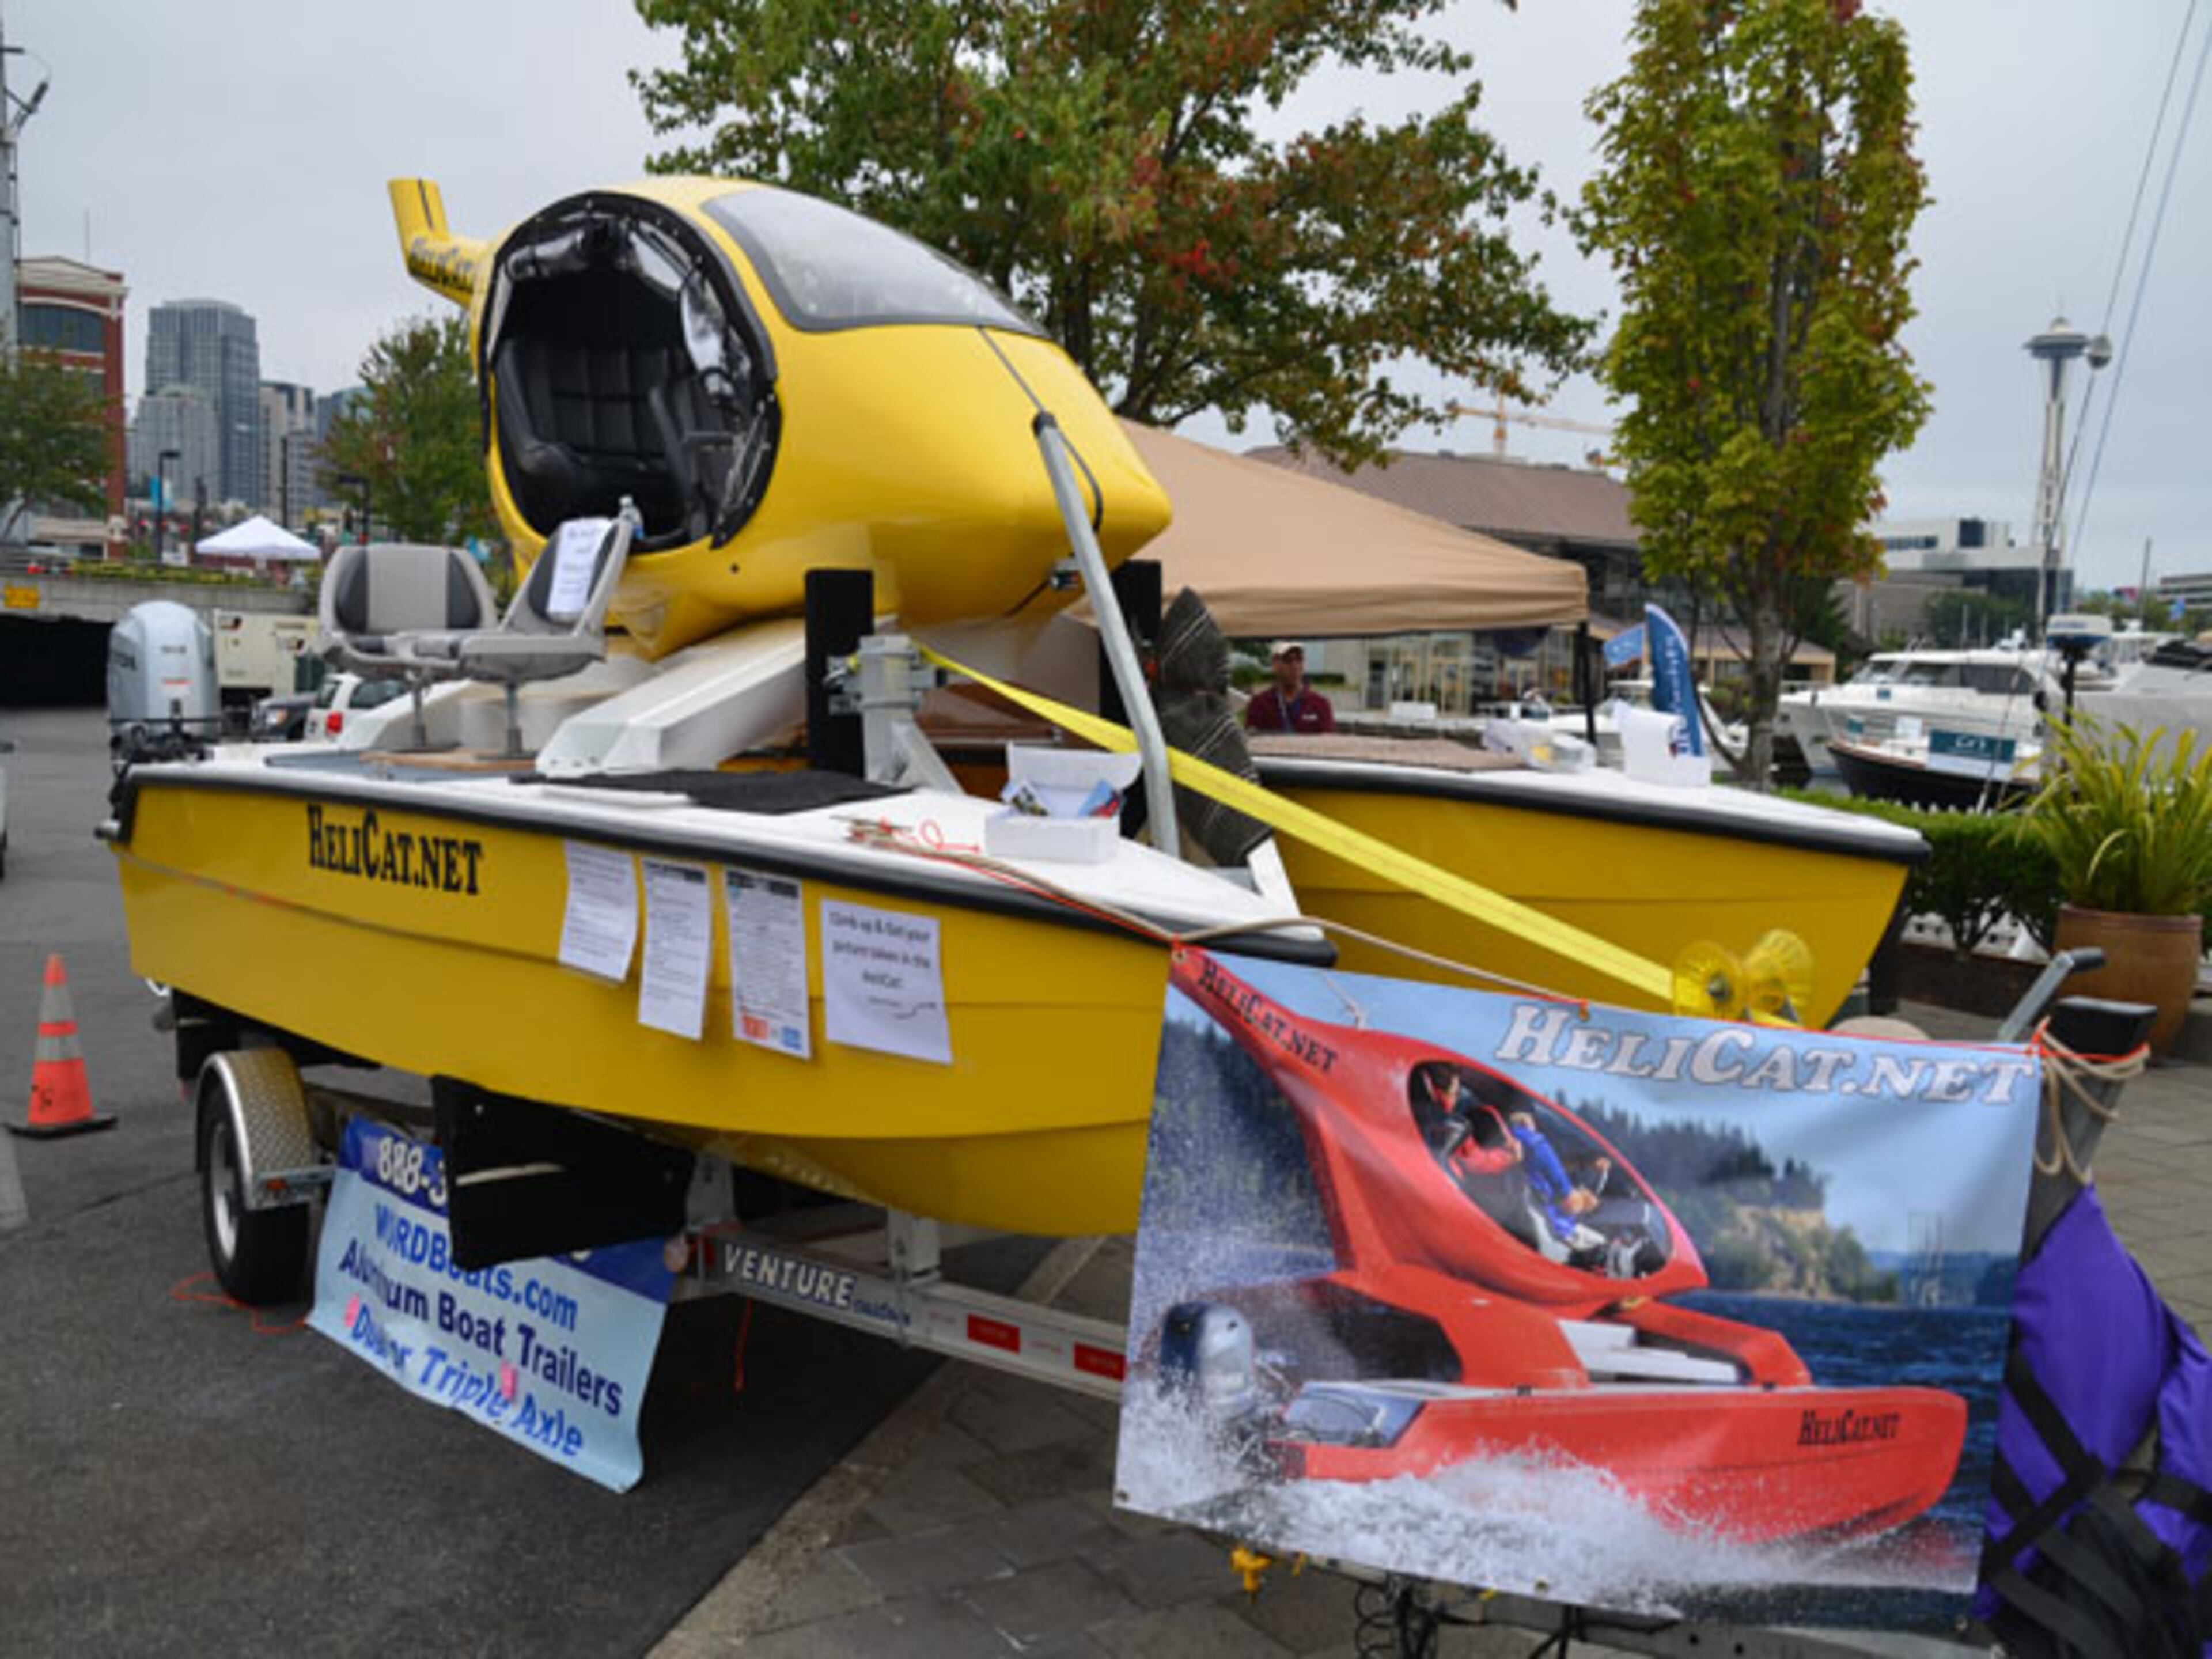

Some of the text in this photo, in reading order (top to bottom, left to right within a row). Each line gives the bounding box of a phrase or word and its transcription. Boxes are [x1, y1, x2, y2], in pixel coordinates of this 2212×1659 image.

[724, 1243, 856, 1309] VENTURE
[418, 1346, 510, 1421] Triple
[510, 1393, 584, 1457] Axle
[437, 1288, 507, 1358] Boat
[517, 1321, 623, 1419] Trailers
